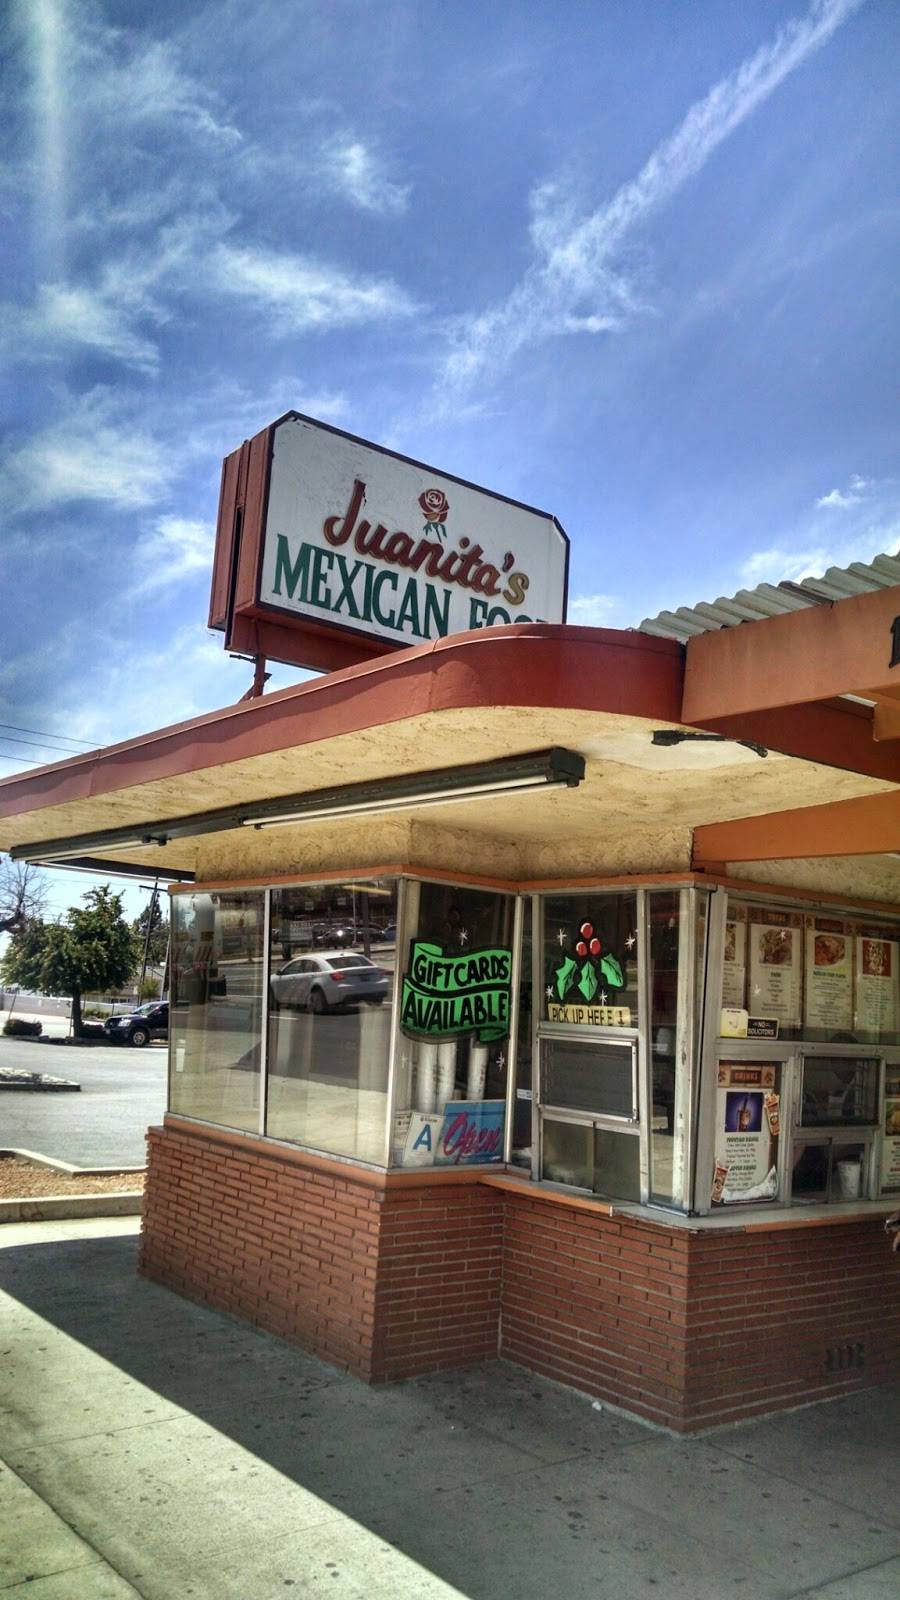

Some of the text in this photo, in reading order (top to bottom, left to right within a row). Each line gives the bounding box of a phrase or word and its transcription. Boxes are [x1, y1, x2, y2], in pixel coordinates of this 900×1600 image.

[323, 479, 529, 605] Juanita's
[271, 533, 452, 641] MEXICAN
[402, 991, 508, 1031] AVAILABLE
[552, 1007, 569, 1024] PICK
[573, 1008, 585, 1025] UP
[616, 1010, 625, 1025] 1
[413, 1124, 432, 1151] A
